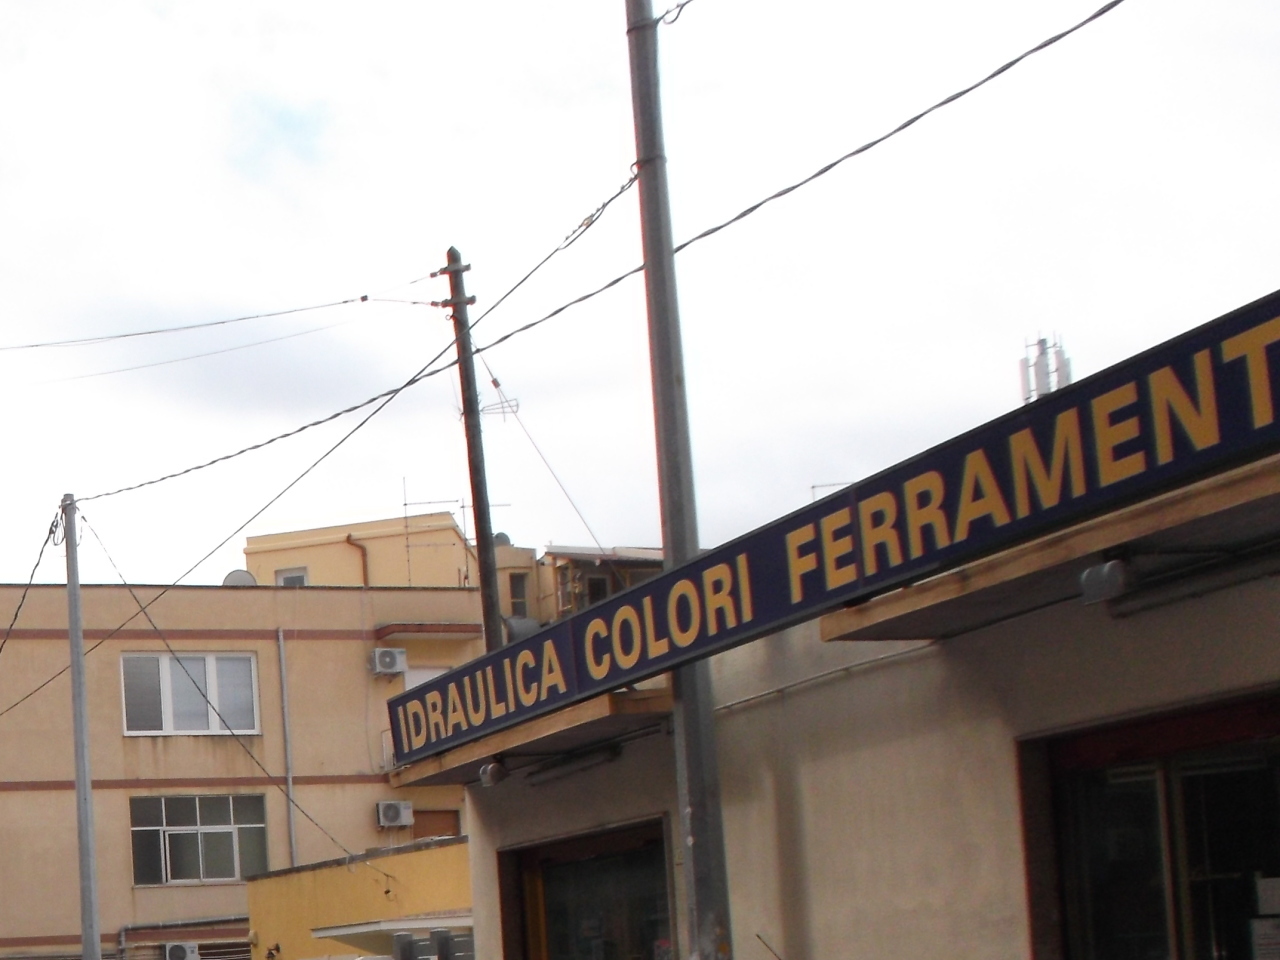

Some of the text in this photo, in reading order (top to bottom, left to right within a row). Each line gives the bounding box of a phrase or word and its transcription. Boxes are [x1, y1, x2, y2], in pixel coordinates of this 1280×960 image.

[397, 315, 1280, 755] IDRAULICA COLORI FERRAMENT
